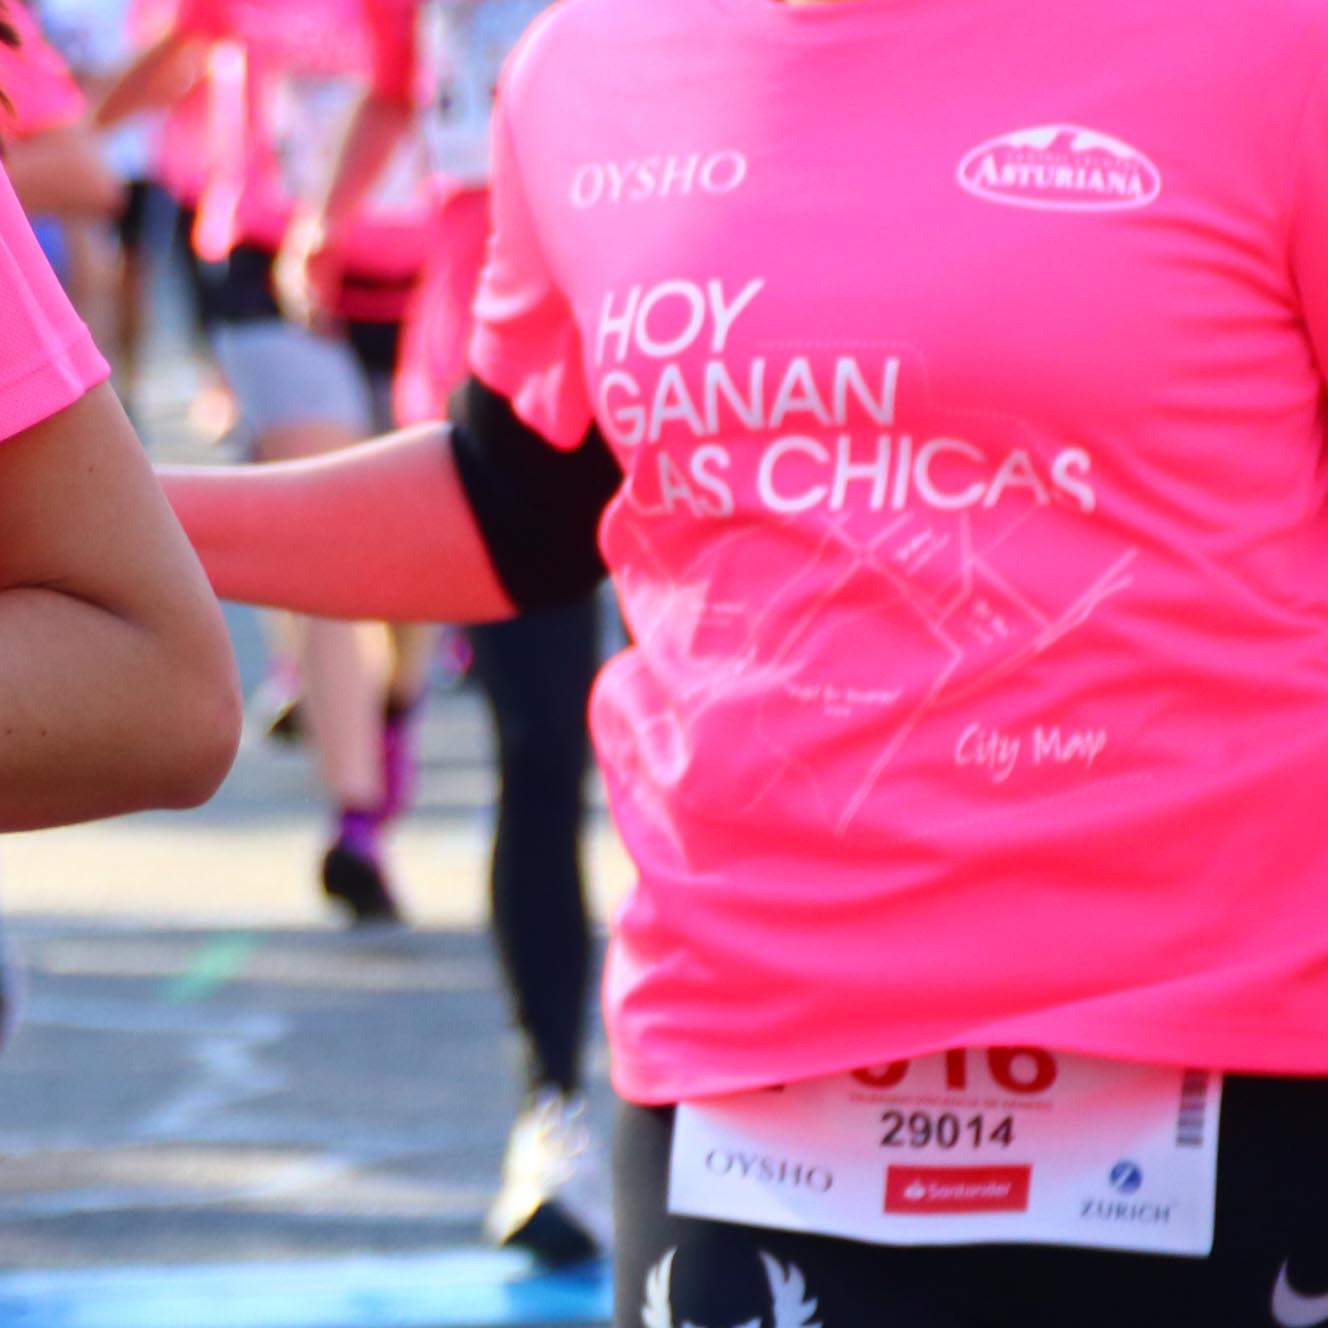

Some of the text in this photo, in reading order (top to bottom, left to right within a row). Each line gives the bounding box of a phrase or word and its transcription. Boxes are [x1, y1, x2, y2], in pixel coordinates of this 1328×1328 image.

[570, 149, 746, 210] OYSHO
[594, 278, 766, 365] HOY
[599, 356, 900, 446] GANAN
[757, 432, 1096, 514] CHICAS
[953, 722, 1107, 782] City Map
[880, 1110, 1015, 1149] 29014
[705, 1150, 834, 1193] OYSHO
